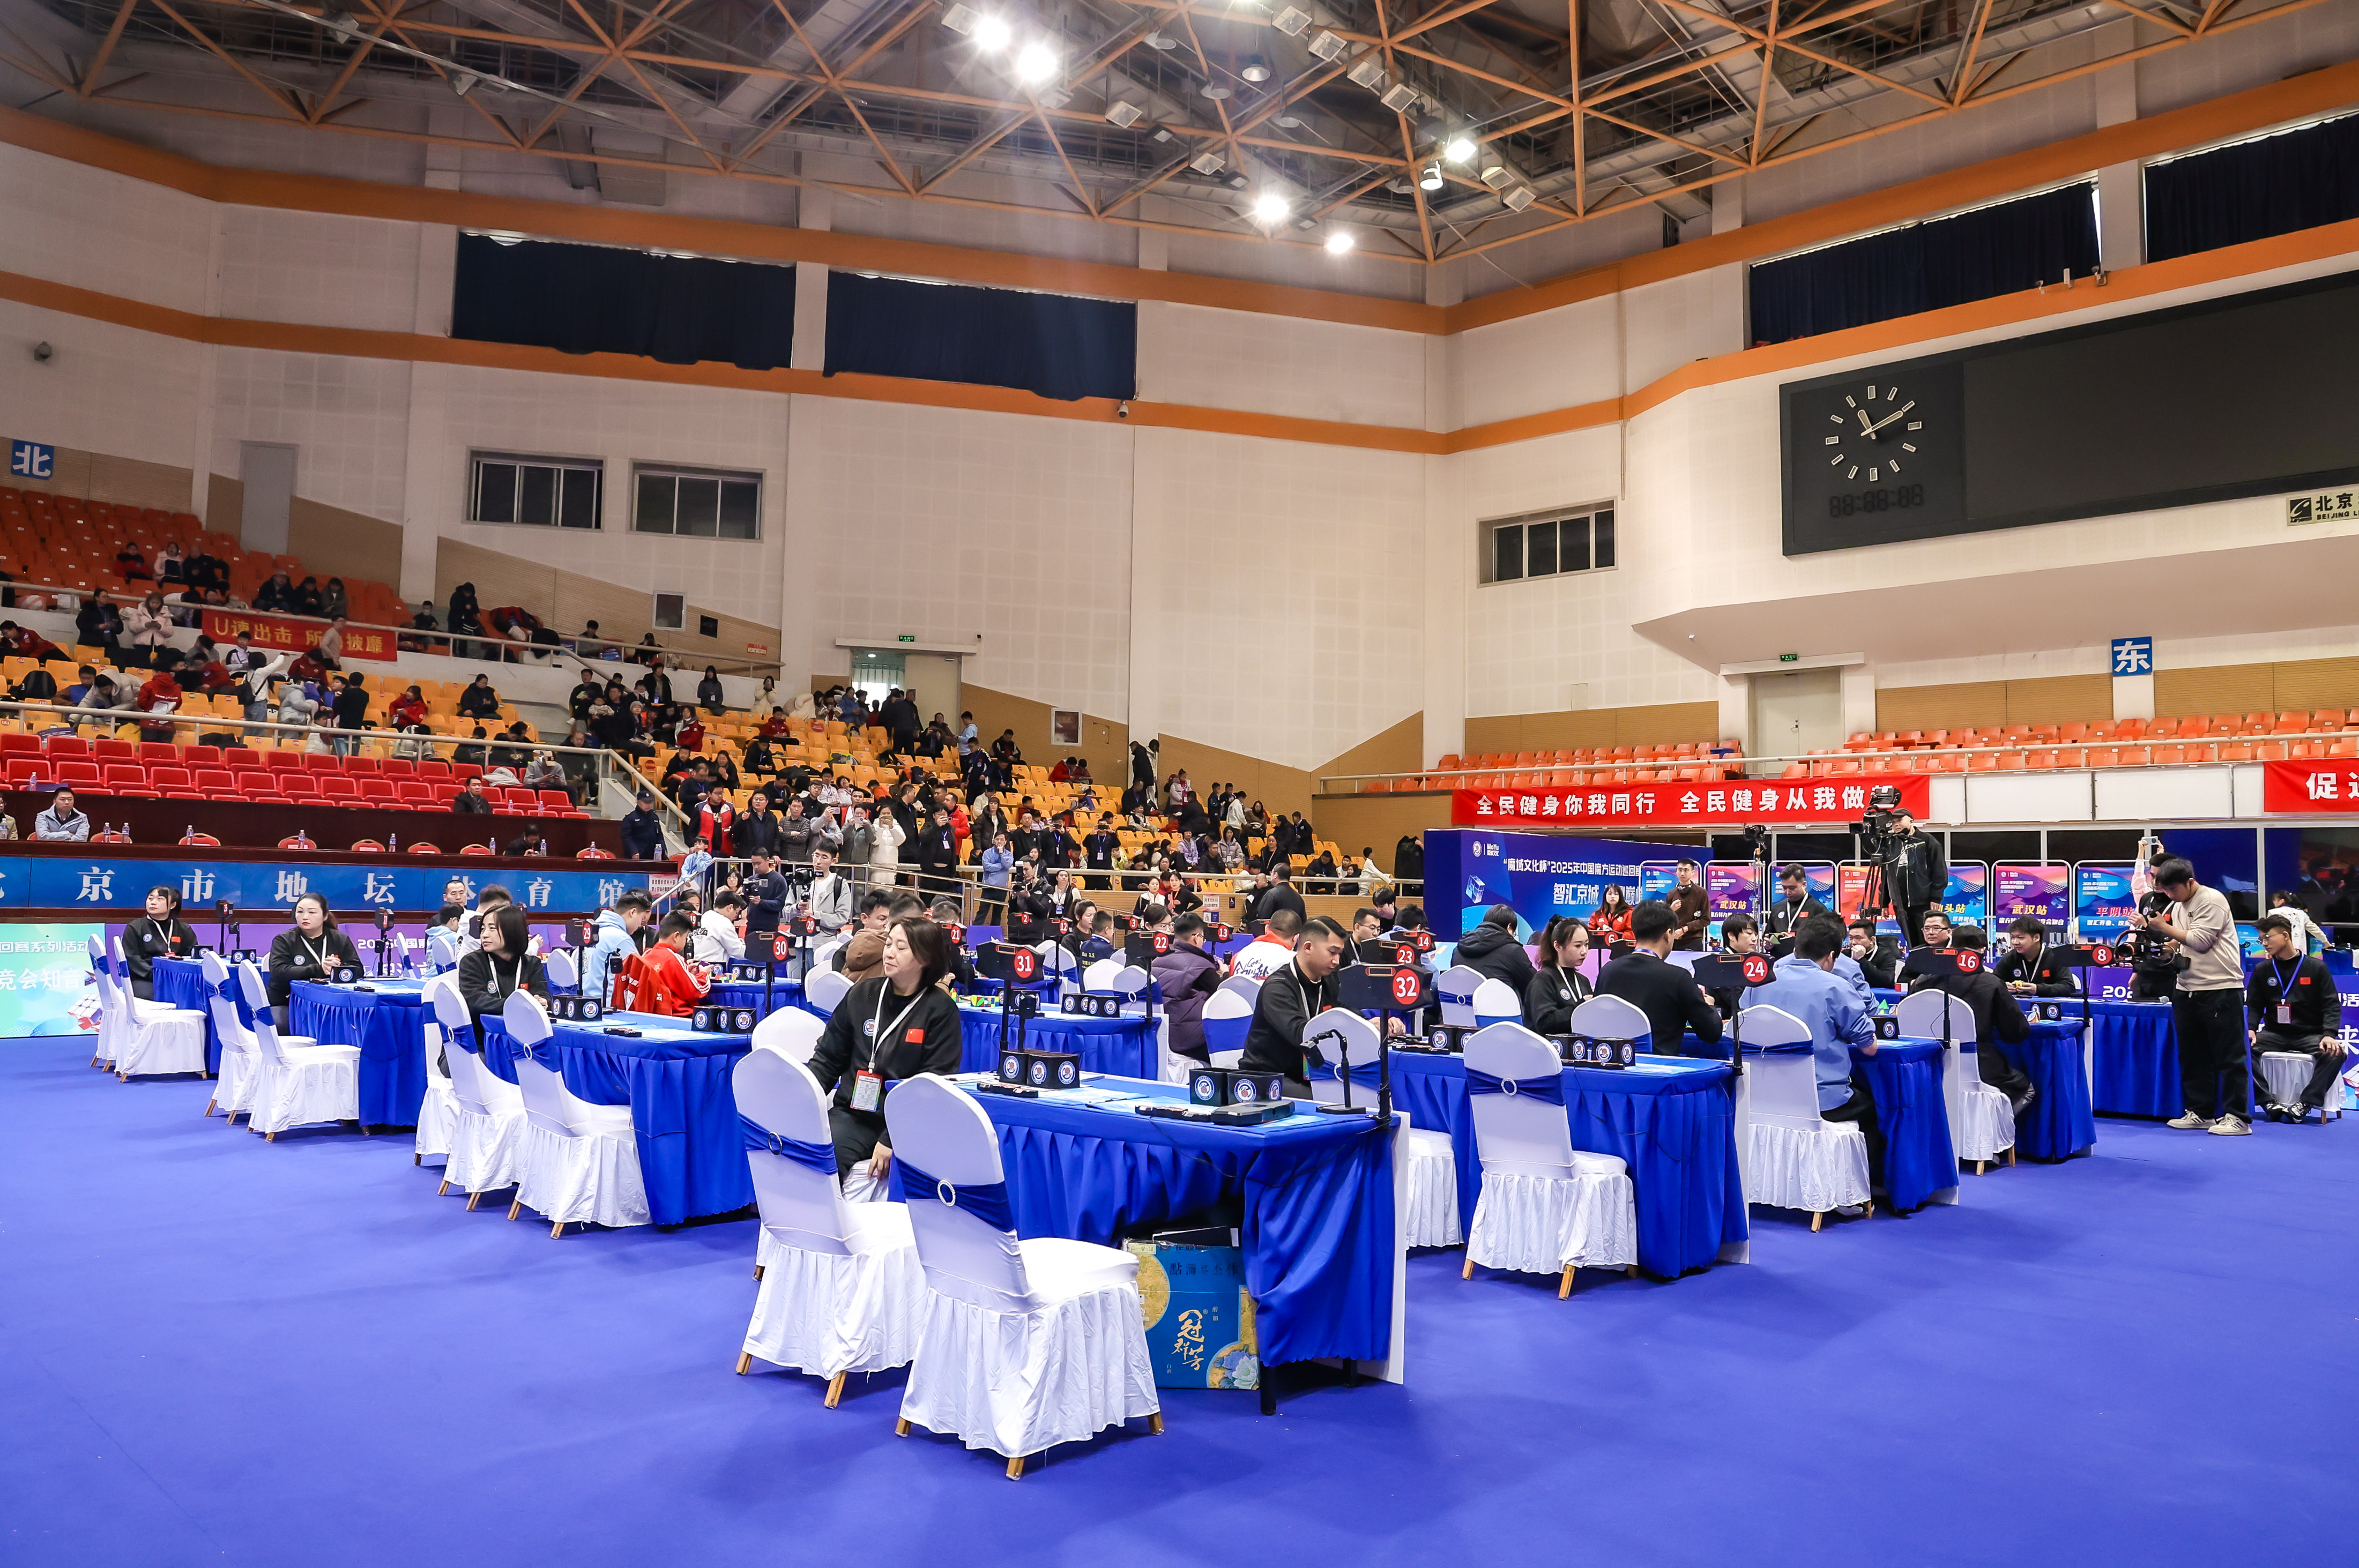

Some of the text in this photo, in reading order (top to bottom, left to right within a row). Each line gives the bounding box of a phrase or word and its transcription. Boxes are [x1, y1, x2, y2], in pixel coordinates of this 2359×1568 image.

[12, 445, 51, 477] 北
[2315, 492, 2354, 511] 北京
[2317, 511, 2350, 520] BEIJING
[306, 630, 383, 653] 所披靡
[2114, 641, 2150, 673] 东
[1476, 792, 1656, 816] 全民健身你我同行
[0, 865, 625, 907] 京市地坛育馆
[1553, 883, 1599, 905] 智汇京城
[1720, 900, 1747, 910] 武汉站
[2012, 905, 2048, 915] 武汉站
[2096, 907, 2134, 917] 平阴站
[690, 915, 696, 924] 19
[807, 920, 814, 930] 20
[1023, 915, 1028, 923] 2
[1132, 919, 1136, 927] 3
[1060, 922, 1067, 931] 12
[1219, 928, 1227, 938] 13
[583, 928, 591, 940] 29
[951, 930, 960, 940] 21
[1608, 934, 1615, 943] 6
[0, 940, 89, 953] 回赛系列活动
[1155, 936, 1168, 950] 22
[1418, 936, 1429, 947] 14
[775, 943, 787, 956] 30
[2097, 949, 2106, 961] 8
[1398, 949, 1412, 964] 23
[1959, 953, 1977, 969] 16
[1017, 955, 1032, 972] 31
[1745, 960, 1765, 977] 24
[1396, 976, 1417, 997] 32
[1171, 1309, 1205, 1371] 冠群芳
